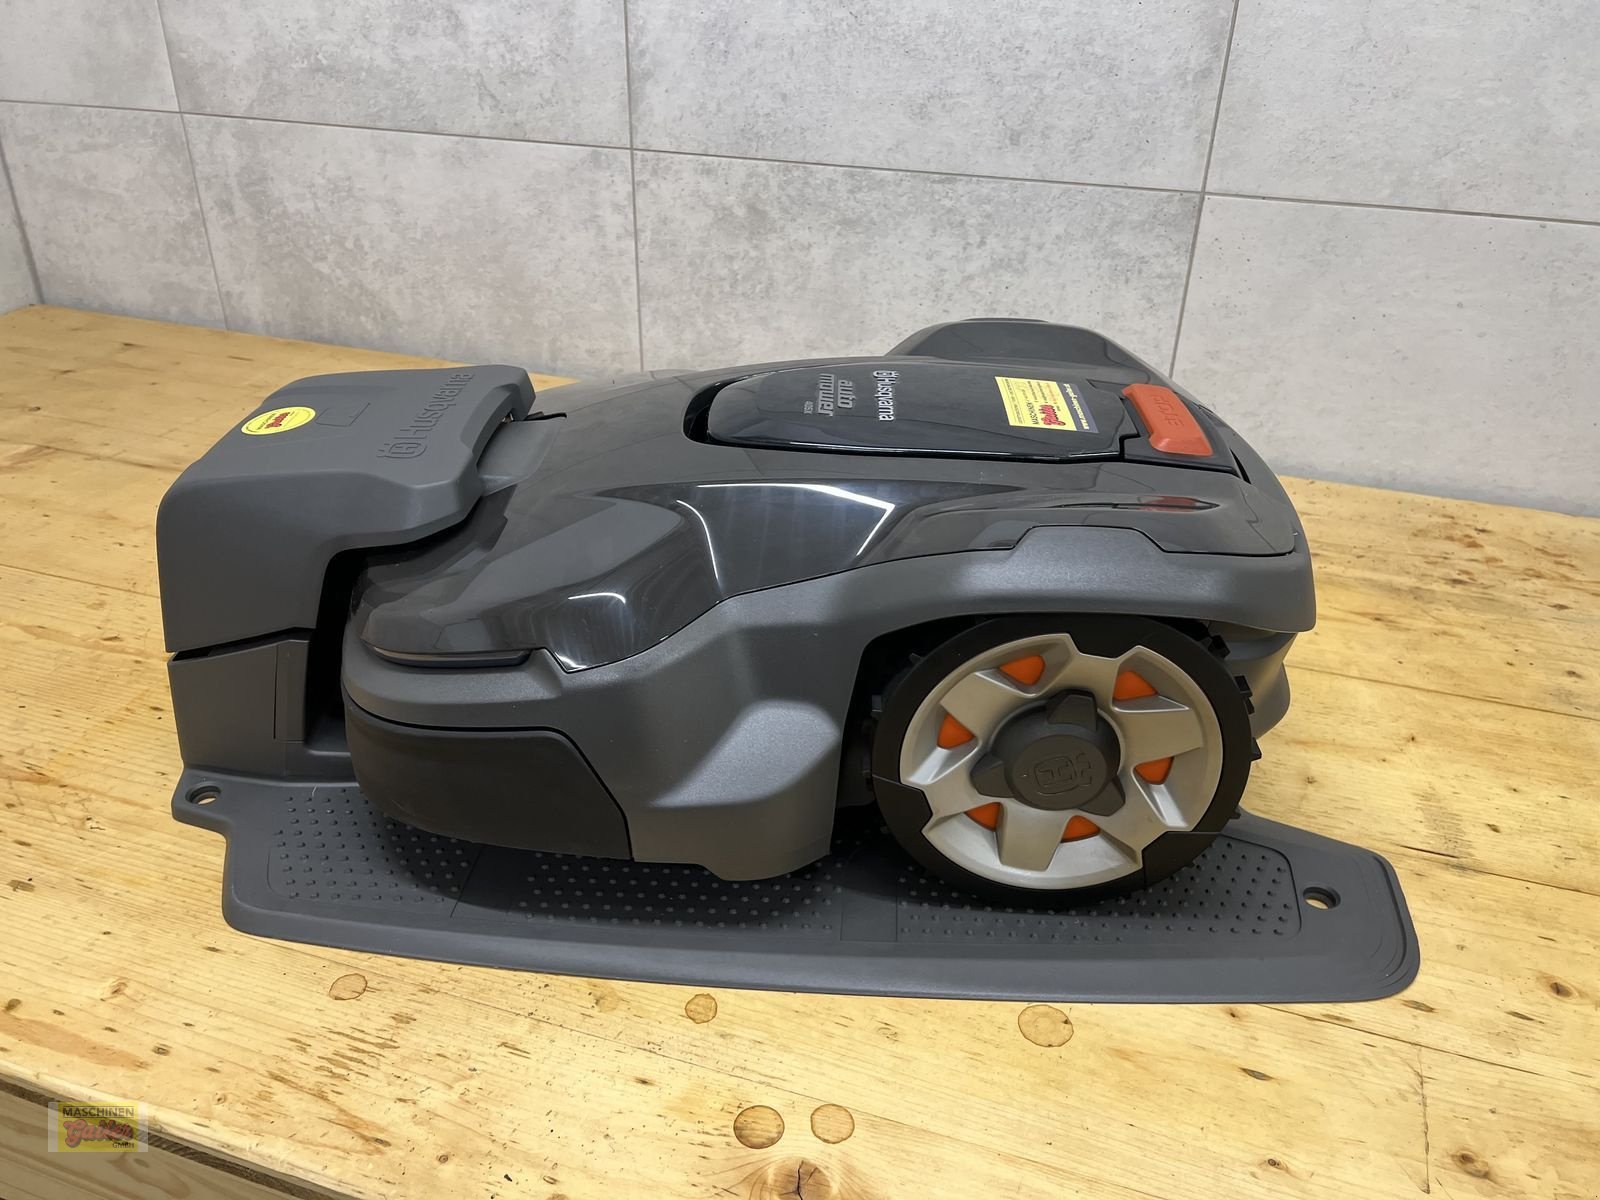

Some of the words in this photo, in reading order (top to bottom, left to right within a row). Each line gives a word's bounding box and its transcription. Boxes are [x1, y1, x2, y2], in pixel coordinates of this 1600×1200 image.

[392, 372, 475, 440] Husqvarna
[818, 373, 834, 416] mower
[838, 379, 855, 408] auto
[874, 377, 896, 421] Husqvarna
